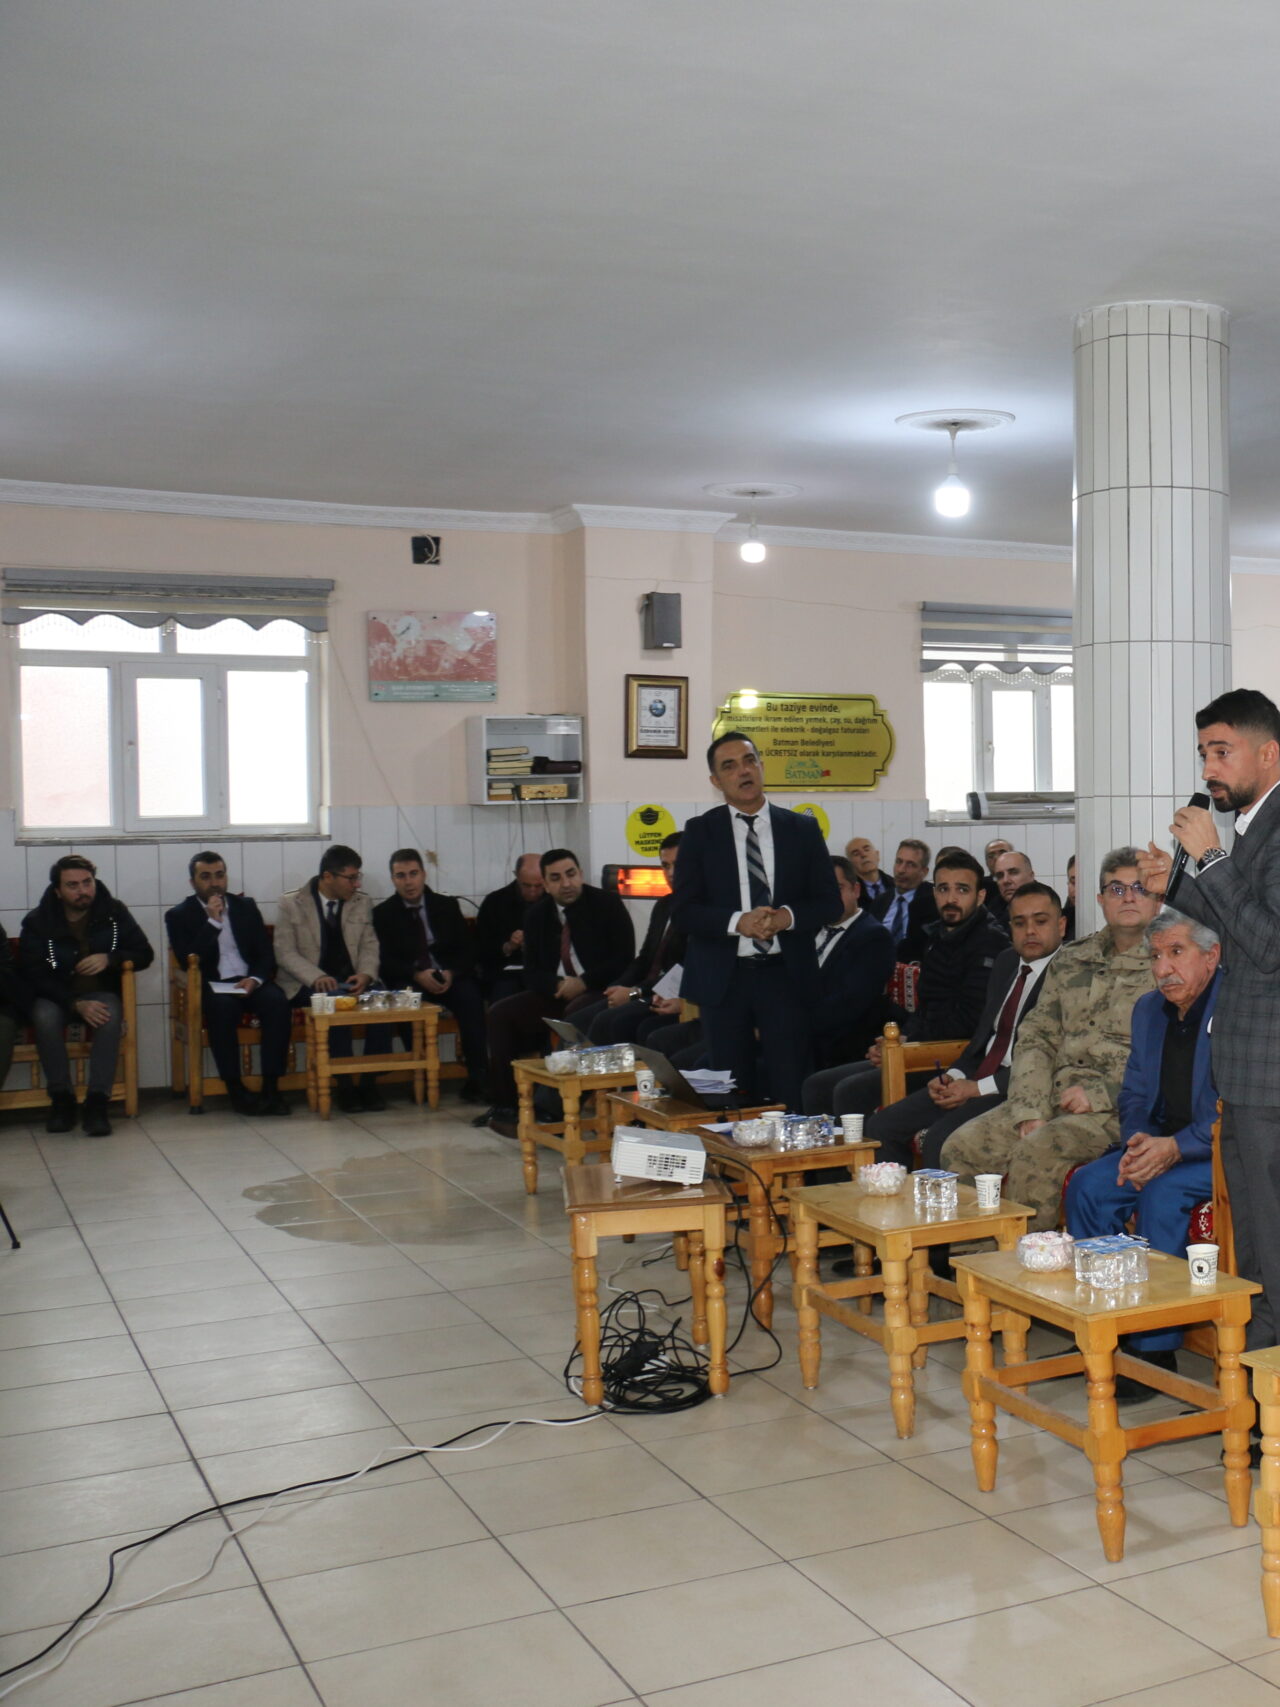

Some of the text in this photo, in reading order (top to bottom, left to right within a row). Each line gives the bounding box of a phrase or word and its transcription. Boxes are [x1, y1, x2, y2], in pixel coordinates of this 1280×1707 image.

[766, 702, 778, 711] Bu
[780, 703, 807, 714] taziye
[773, 738, 836, 748] Batman Belediyesi
[765, 747, 798, 757] ÜCRETSİZ
[784, 768, 823, 779] BATMAN
